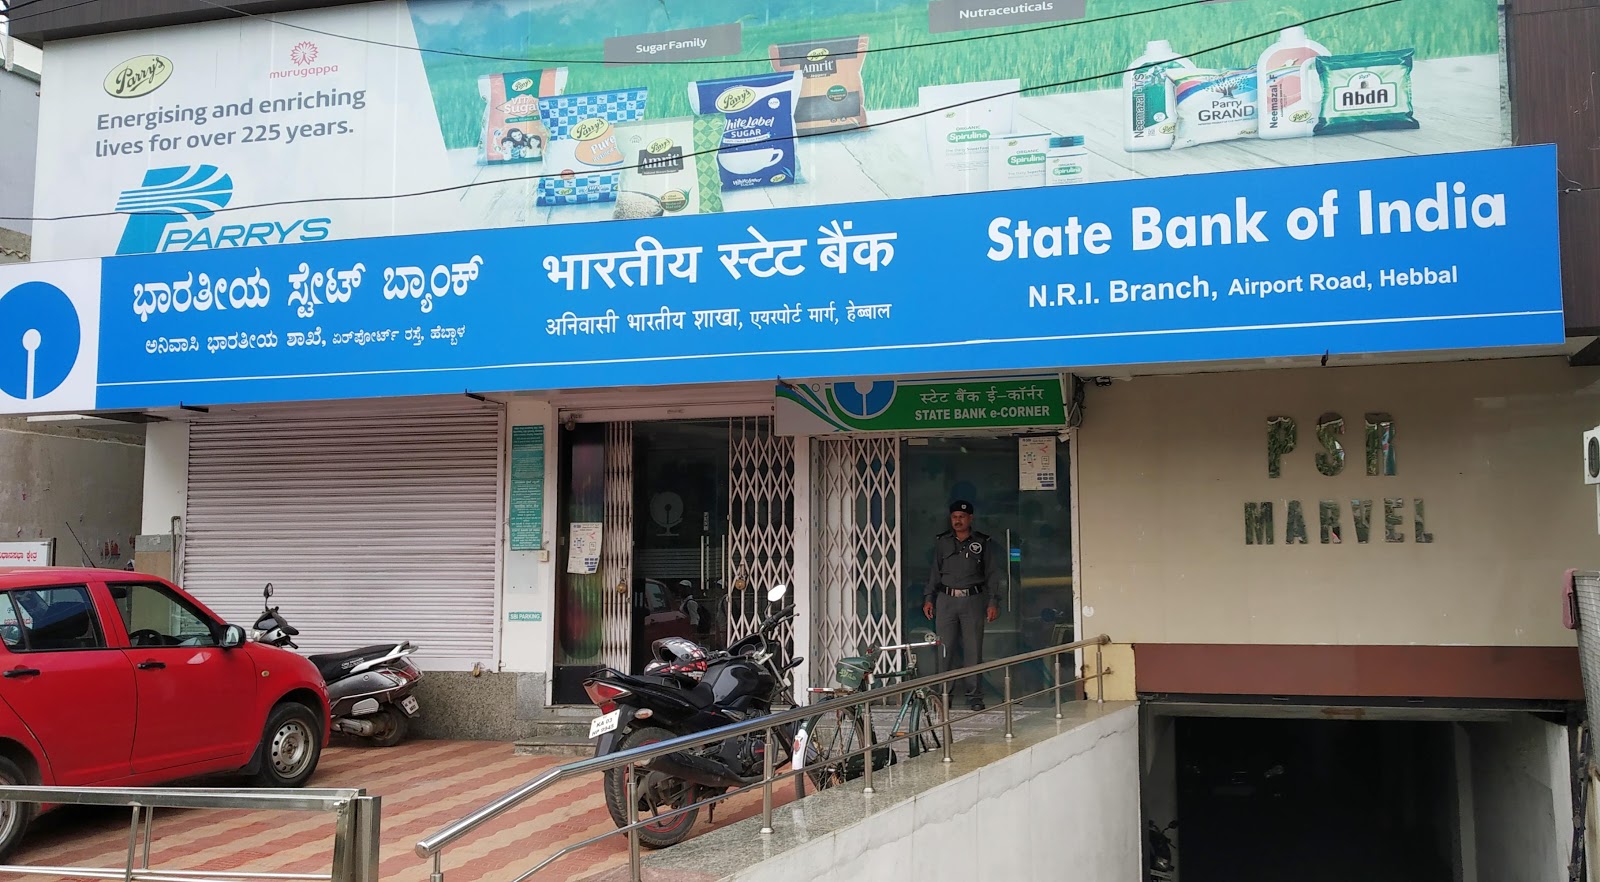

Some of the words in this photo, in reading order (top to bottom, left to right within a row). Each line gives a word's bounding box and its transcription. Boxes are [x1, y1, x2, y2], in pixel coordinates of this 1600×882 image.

[959, 1, 1054, 20] Nutraceuticals
[635, 43, 668, 55] Sugar
[668, 37, 708, 52] Family
[115, 56, 164, 94] Parry's
[269, 64, 339, 79] murugappa
[803, 60, 834, 73] Amrit
[723, 89, 752, 109] Parry's
[1211, 100, 1243, 109] Parry
[1269, 84, 1278, 129] Neemazal
[1342, 88, 1389, 106] AbdA
[97, 104, 208, 132] Energising
[212, 98, 253, 118] and
[259, 88, 367, 114] enriching
[504, 104, 537, 115] Suga
[1134, 93, 1145, 138] Neemazal
[1198, 105, 1255, 122] GRAND
[577, 119, 605, 139] Parry's
[725, 117, 746, 130] hite
[745, 116, 775, 128] Label
[96, 140, 144, 158] lives
[148, 134, 182, 152] for
[186, 129, 237, 149] over
[240, 123, 281, 143] 225
[285, 119, 355, 145] years.
[731, 128, 762, 138] SUGAR
[949, 130, 989, 143] Spirulina
[591, 136, 616, 155] Pure
[642, 153, 680, 169] Amrit
[1010, 153, 1045, 165] Spirulina
[986, 215, 1113, 262] State
[1131, 196, 1270, 251] Bank
[1286, 188, 1339, 241] of
[1358, 181, 1507, 236] India
[161, 217, 332, 252] PARRYS
[542, 235, 703, 291] भारतीय
[717, 225, 808, 280] स्टेट
[817, 219, 898, 274] बैंक
[132, 266, 271, 323] ಭಾರತೀಯ
[287, 262, 366, 319] ಸ್ಟೇಟ್
[382, 254, 484, 314] ಬ್ಯಾಂಕ್
[1028, 282, 1100, 308] N.R.I.
[1109, 275, 1218, 303] Branch,
[1228, 276, 1304, 299] Airport
[1309, 270, 1373, 292] Road,
[1379, 264, 1458, 287] Hebbal
[545, 308, 620, 336] अनिवासी
[626, 305, 686, 332] भारतीय
[692, 307, 744, 332] शाखा,
[749, 303, 802, 326] एयरपोर्ट
[808, 301, 840, 325] मार्ग,
[845, 300, 893, 321] हेब्बाल
[145, 336, 200, 354] ಅನಿವಾಸಿ
[207, 329, 279, 352] ಭಾರತೀಯ
[286, 326, 327, 347] ಶಾಖೆ,
[430, 324, 466, 346] ಹೆಬ್ಬಾಳ
[919, 389, 949, 405] स्टेट
[954, 387, 981, 403] बैंक
[914, 408, 952, 421] STATE
[953, 406, 987, 420] BANK
[989, 405, 1050, 418] e-CORNER
[1243, 497, 1434, 545] MARVEL
